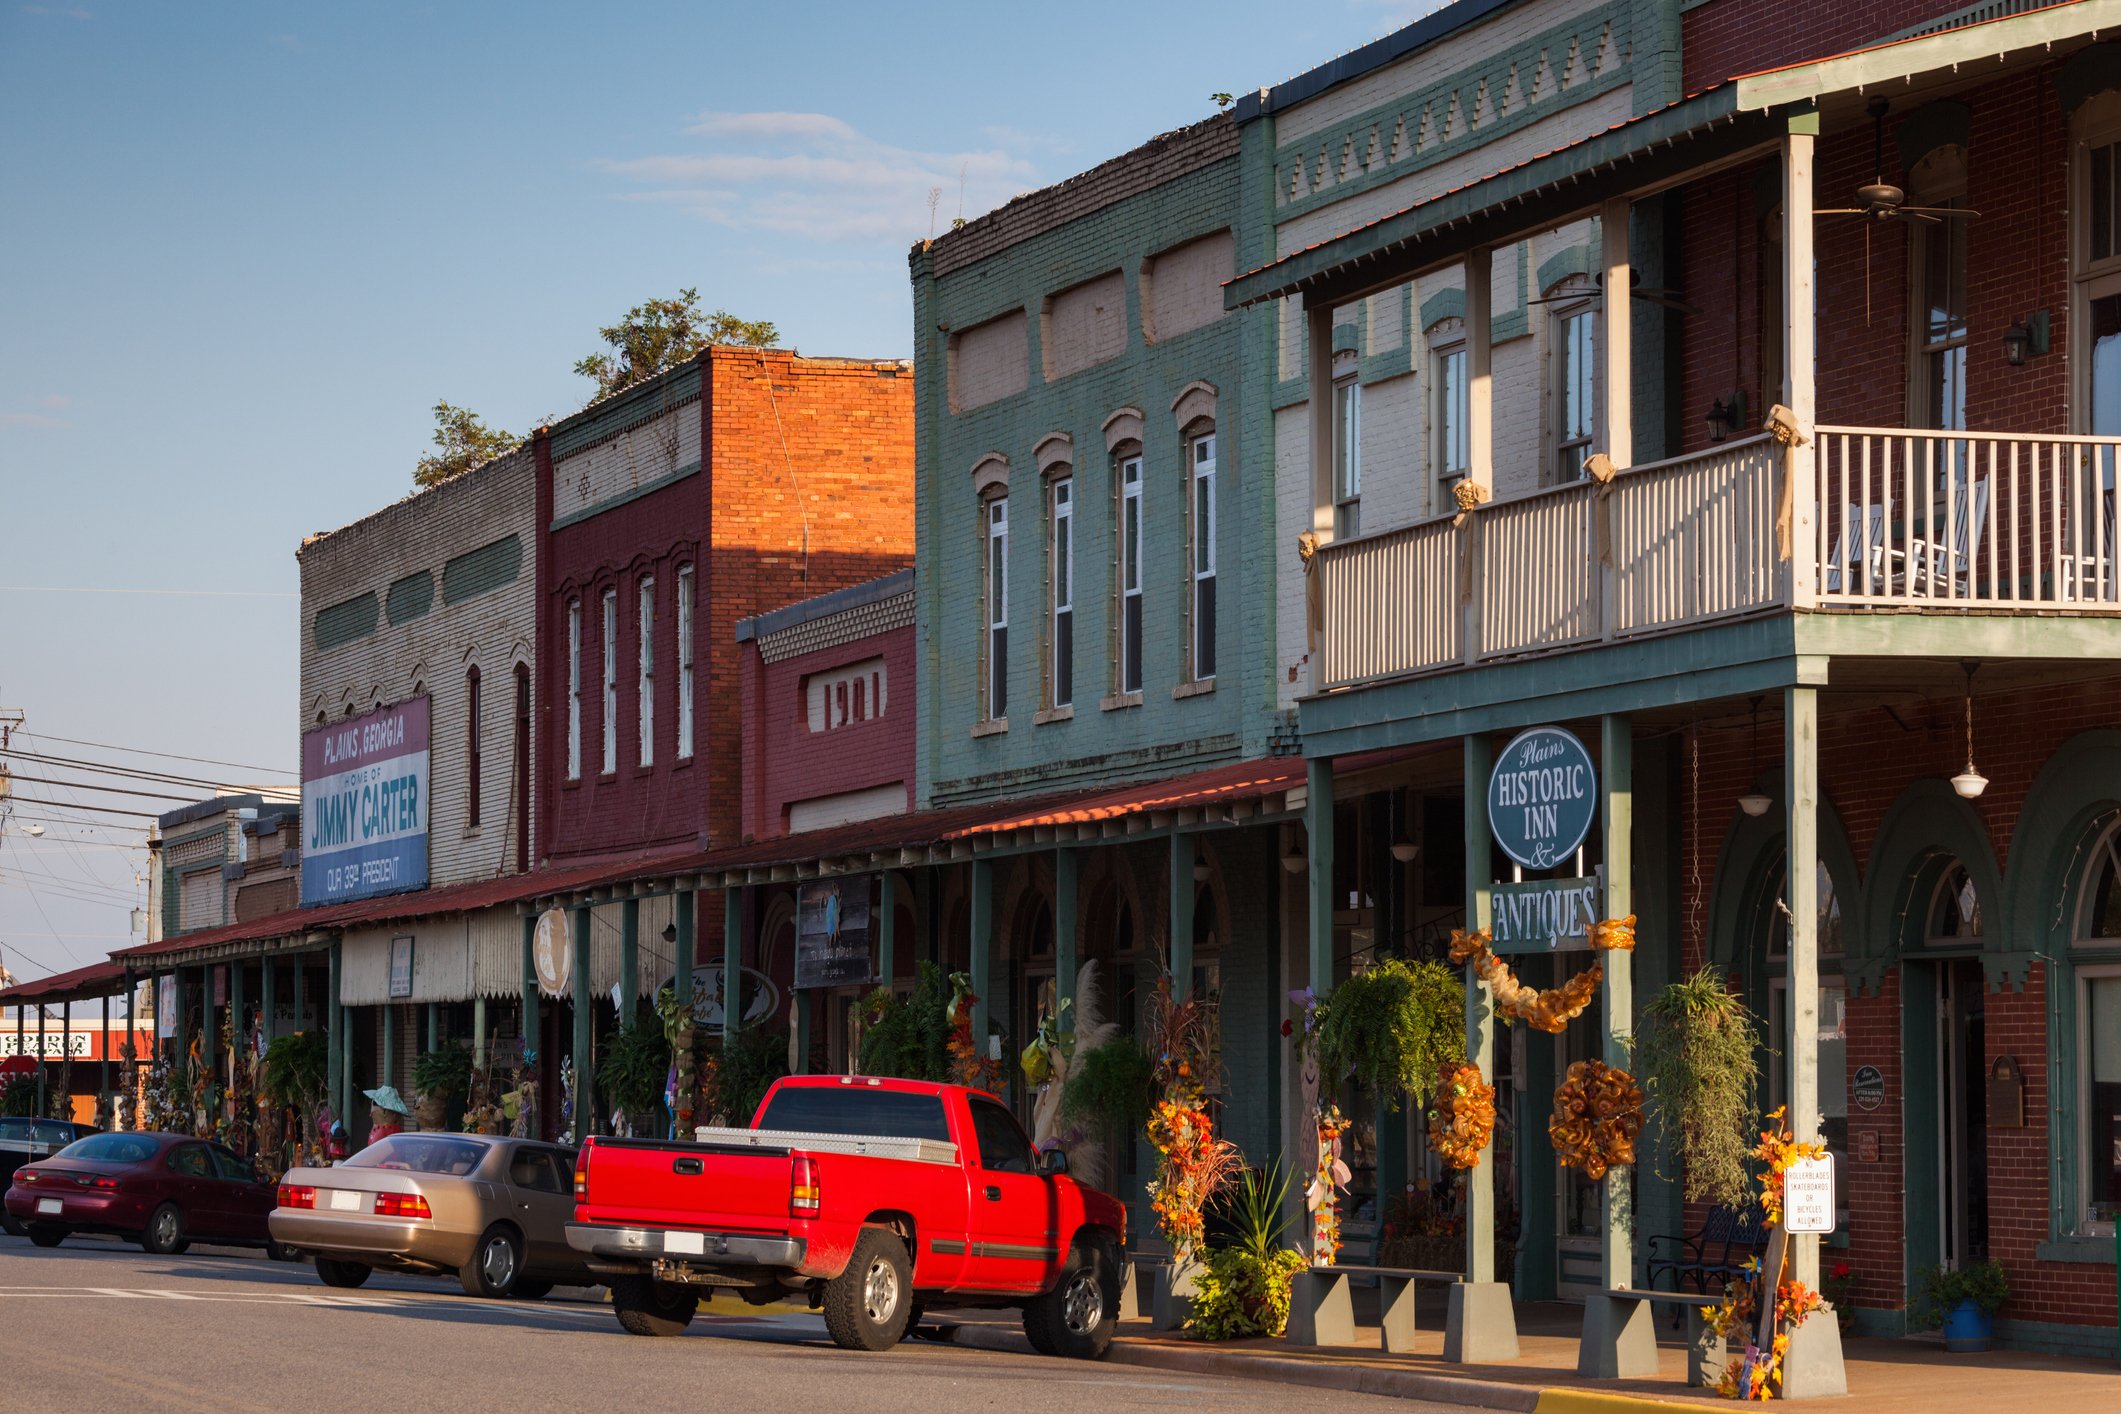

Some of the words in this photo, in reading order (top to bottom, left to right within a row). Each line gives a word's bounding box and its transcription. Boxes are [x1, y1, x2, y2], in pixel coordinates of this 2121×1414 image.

[824, 671, 880, 730] 1901
[324, 727, 361, 766] PLAINS,
[363, 714, 404, 754] GEORGIA
[1519, 738, 1565, 768] Plains
[345, 771, 368, 788] HOME
[371, 767, 381, 780] OF
[1498, 763, 1584, 807] HISTORIC
[311, 789, 359, 849] JIMMY
[362, 774, 418, 839] CARTER
[1524, 804, 1558, 841] INN
[1530, 842, 1555, 868] &
[327, 867, 342, 892] OUR
[362, 856, 400, 885] PRESIDENT
[1492, 885, 1596, 950] ANTIQUES
[1788, 1171, 1830, 1180] ROLLERBLADES
[1805, 1161, 1813, 1169] NO
[1790, 1183, 1829, 1191] SKATEBOARDS
[1805, 1194, 1814, 1202] OR
[1797, 1205, 1822, 1214] BICYCLES
[1797, 1216, 1822, 1225] ALLOWED
